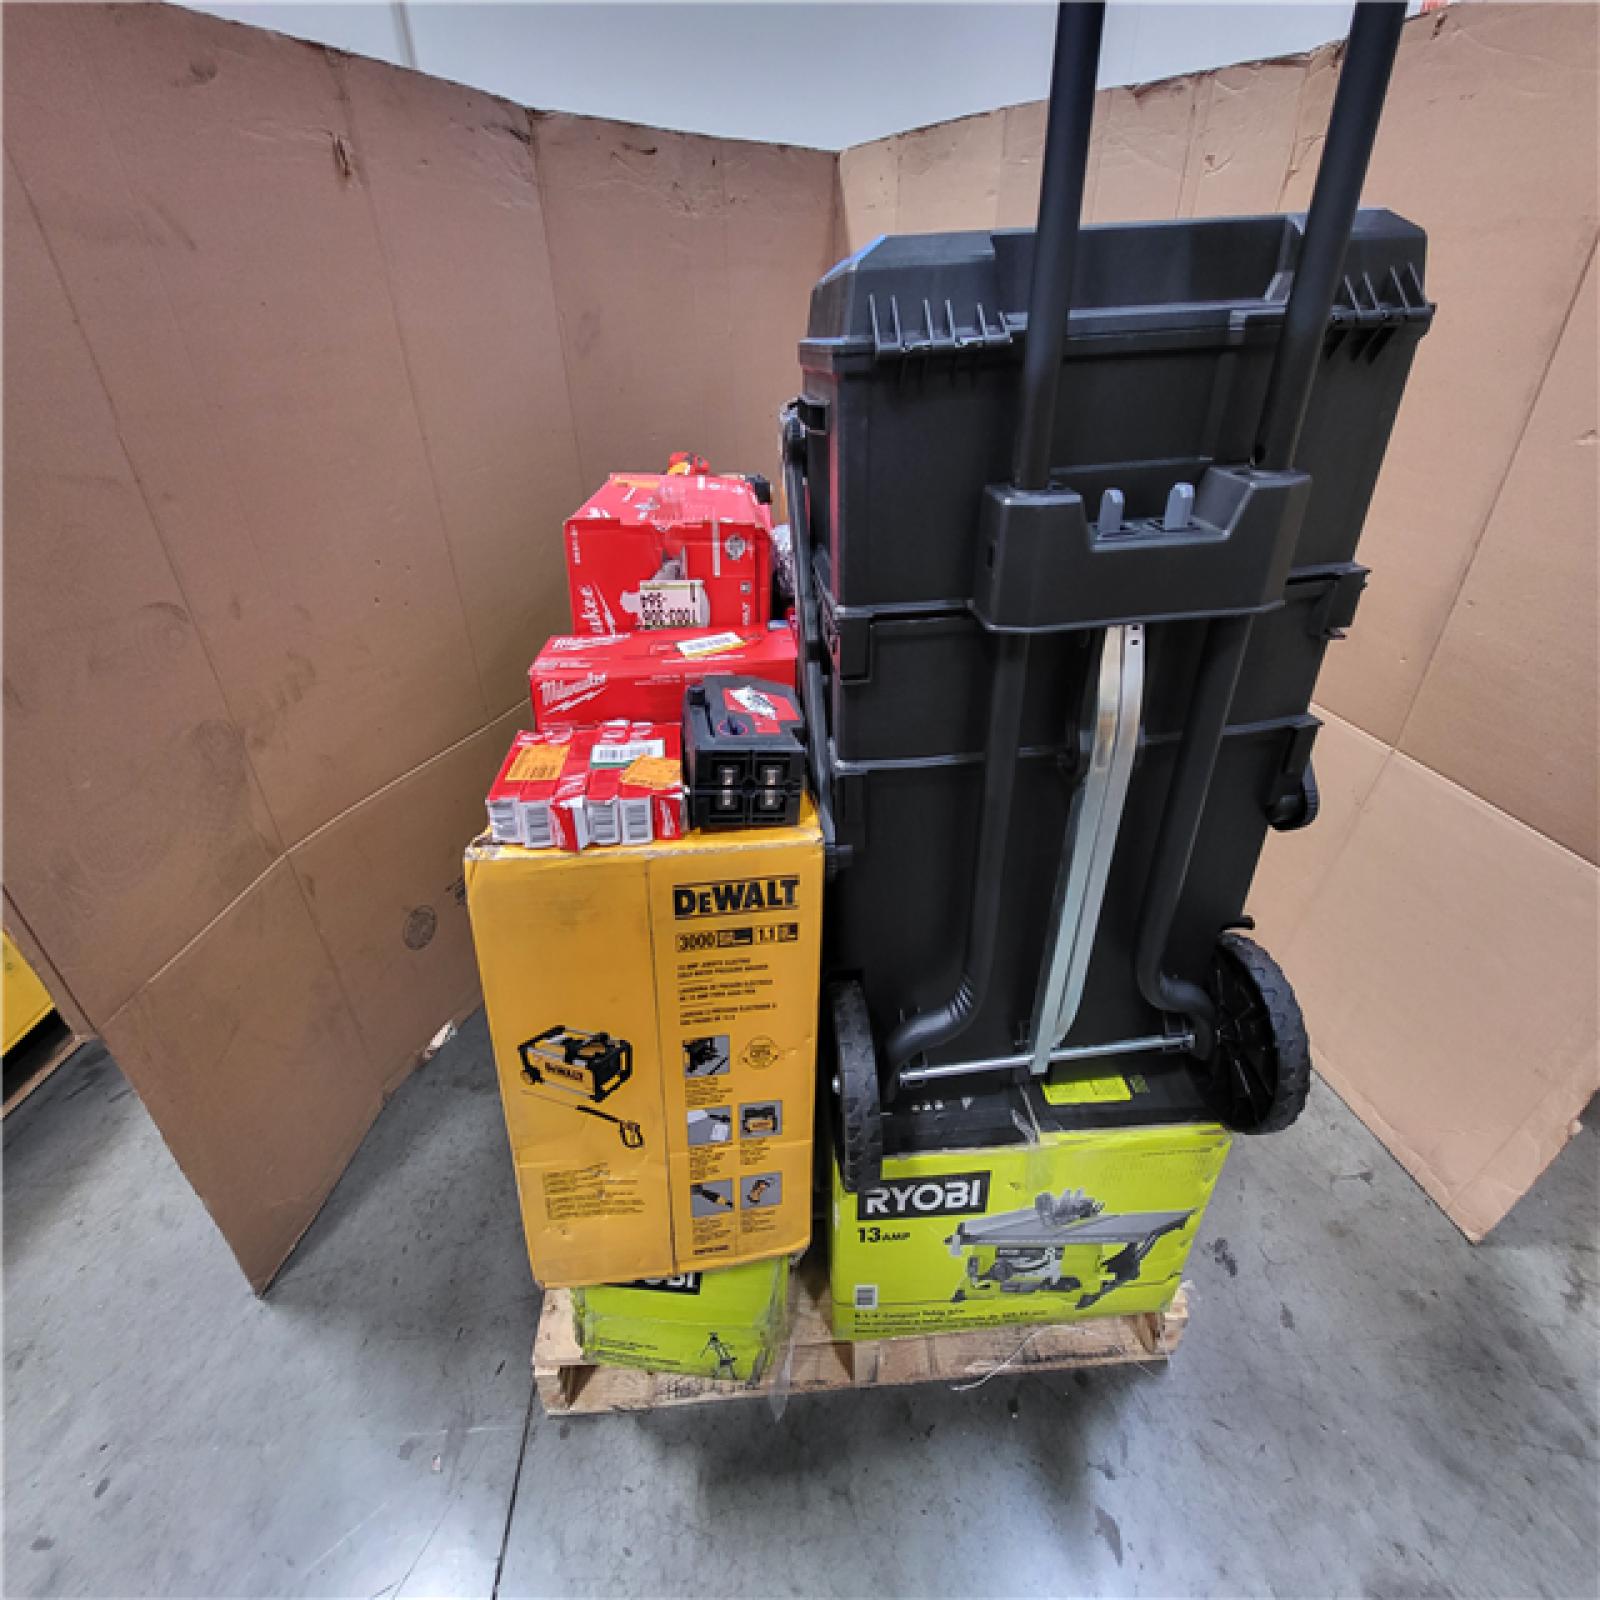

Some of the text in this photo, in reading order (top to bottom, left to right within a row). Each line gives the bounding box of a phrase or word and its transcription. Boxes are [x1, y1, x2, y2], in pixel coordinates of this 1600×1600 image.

[677, 932, 716, 952] 3000
[864, 1179, 981, 1214] RYOBI
[857, 1227, 881, 1244] 13
